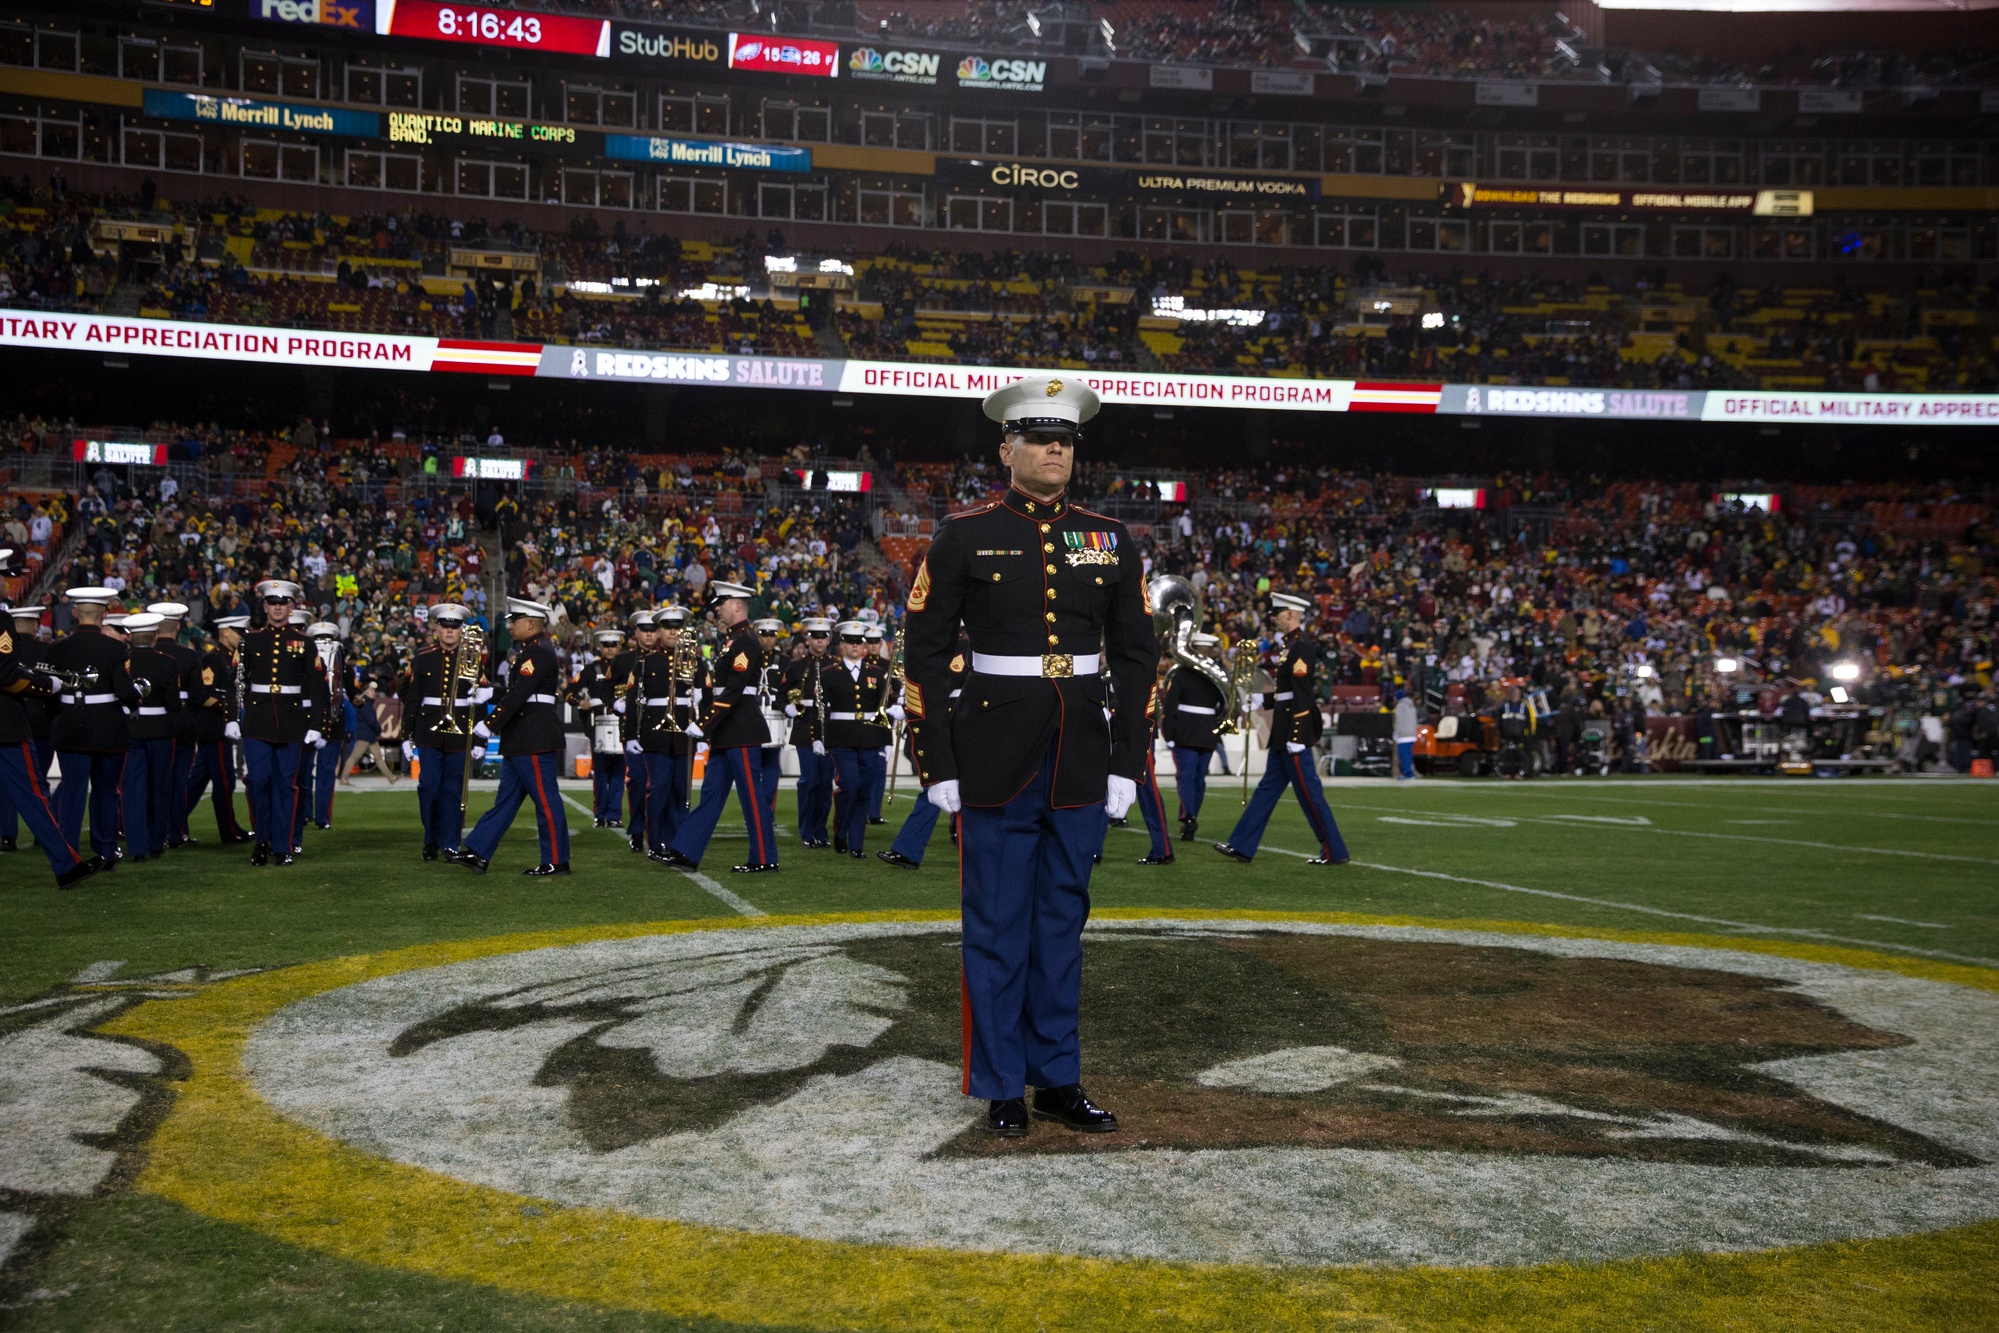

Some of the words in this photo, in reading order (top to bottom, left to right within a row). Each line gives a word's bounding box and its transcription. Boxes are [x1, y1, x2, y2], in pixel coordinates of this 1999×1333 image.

[438, 8, 542, 43] 8:16:43
[619, 30, 719, 61] StubHub
[884, 51, 940, 75] CSN
[990, 59, 1046, 83] CSN
[222, 102, 279, 125] Merrill
[284, 107, 334, 131] Lynch
[389, 112, 462, 134] QUANTICO
[469, 119, 524, 139] MARINE
[530, 125, 576, 144] CORPS
[671, 143, 722, 164] Merrill
[726, 147, 771, 167] Lynch
[991, 163, 1080, 190] CÎROC
[1138, 176, 1184, 190] ULTRA
[1186, 178, 1255, 193] PREMIUM
[1256, 181, 1307, 195] VODKA
[86, 324, 278, 354] APPRECIATION
[288, 337, 412, 362] PROGRAM
[596, 353, 730, 382] REDSKINS
[736, 360, 824, 386] SALUTE
[864, 368, 960, 390] OFFICIAL
[1076, 378, 1224, 400] PPRECIATION
[1232, 385, 1332, 403] PROGRAM
[1488, 390, 1604, 414] REDSKINS
[1609, 393, 1688, 416] SALUTE
[1725, 398, 1813, 416] OFFICIAL
[1820, 400, 1911, 418] MILITARY
[104, 451, 150, 464] SALUTE
[480, 466, 521, 479] SALUTE
